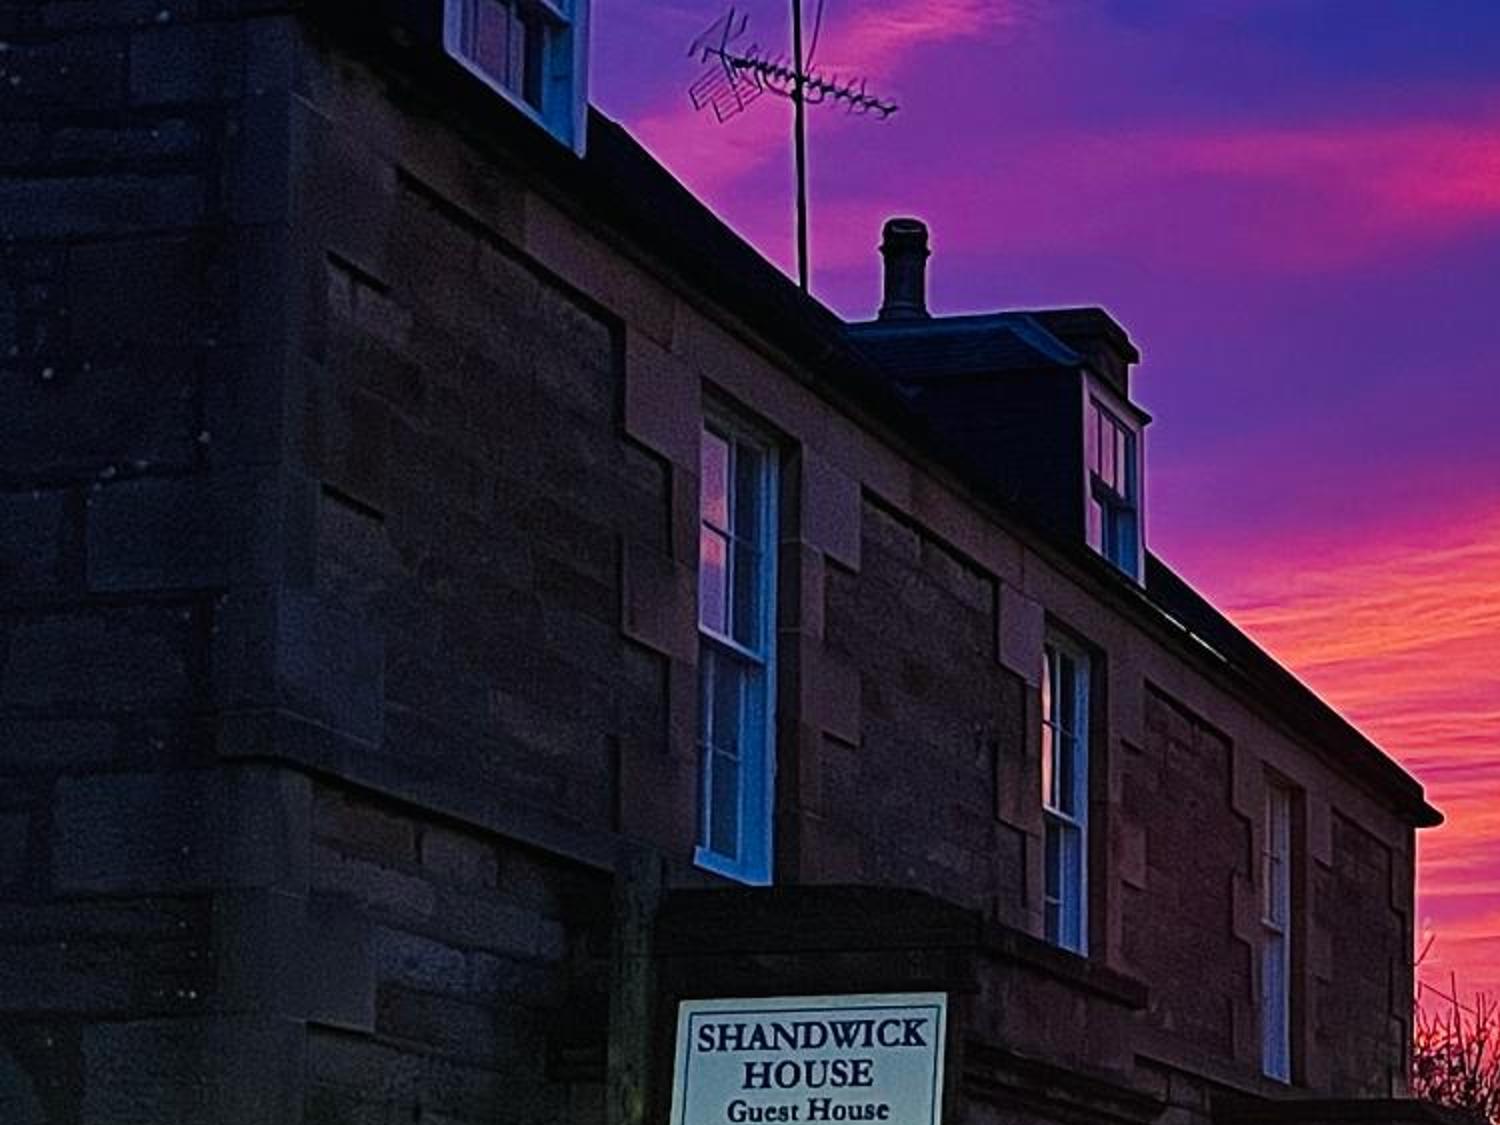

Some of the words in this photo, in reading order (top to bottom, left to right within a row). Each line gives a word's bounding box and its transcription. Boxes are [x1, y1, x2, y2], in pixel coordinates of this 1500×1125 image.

[697, 1018, 928, 1052] SHANDWICK
[741, 1059, 874, 1090] HOUSE
[727, 1100, 799, 1122] Guest
[806, 1098, 890, 1121] House
